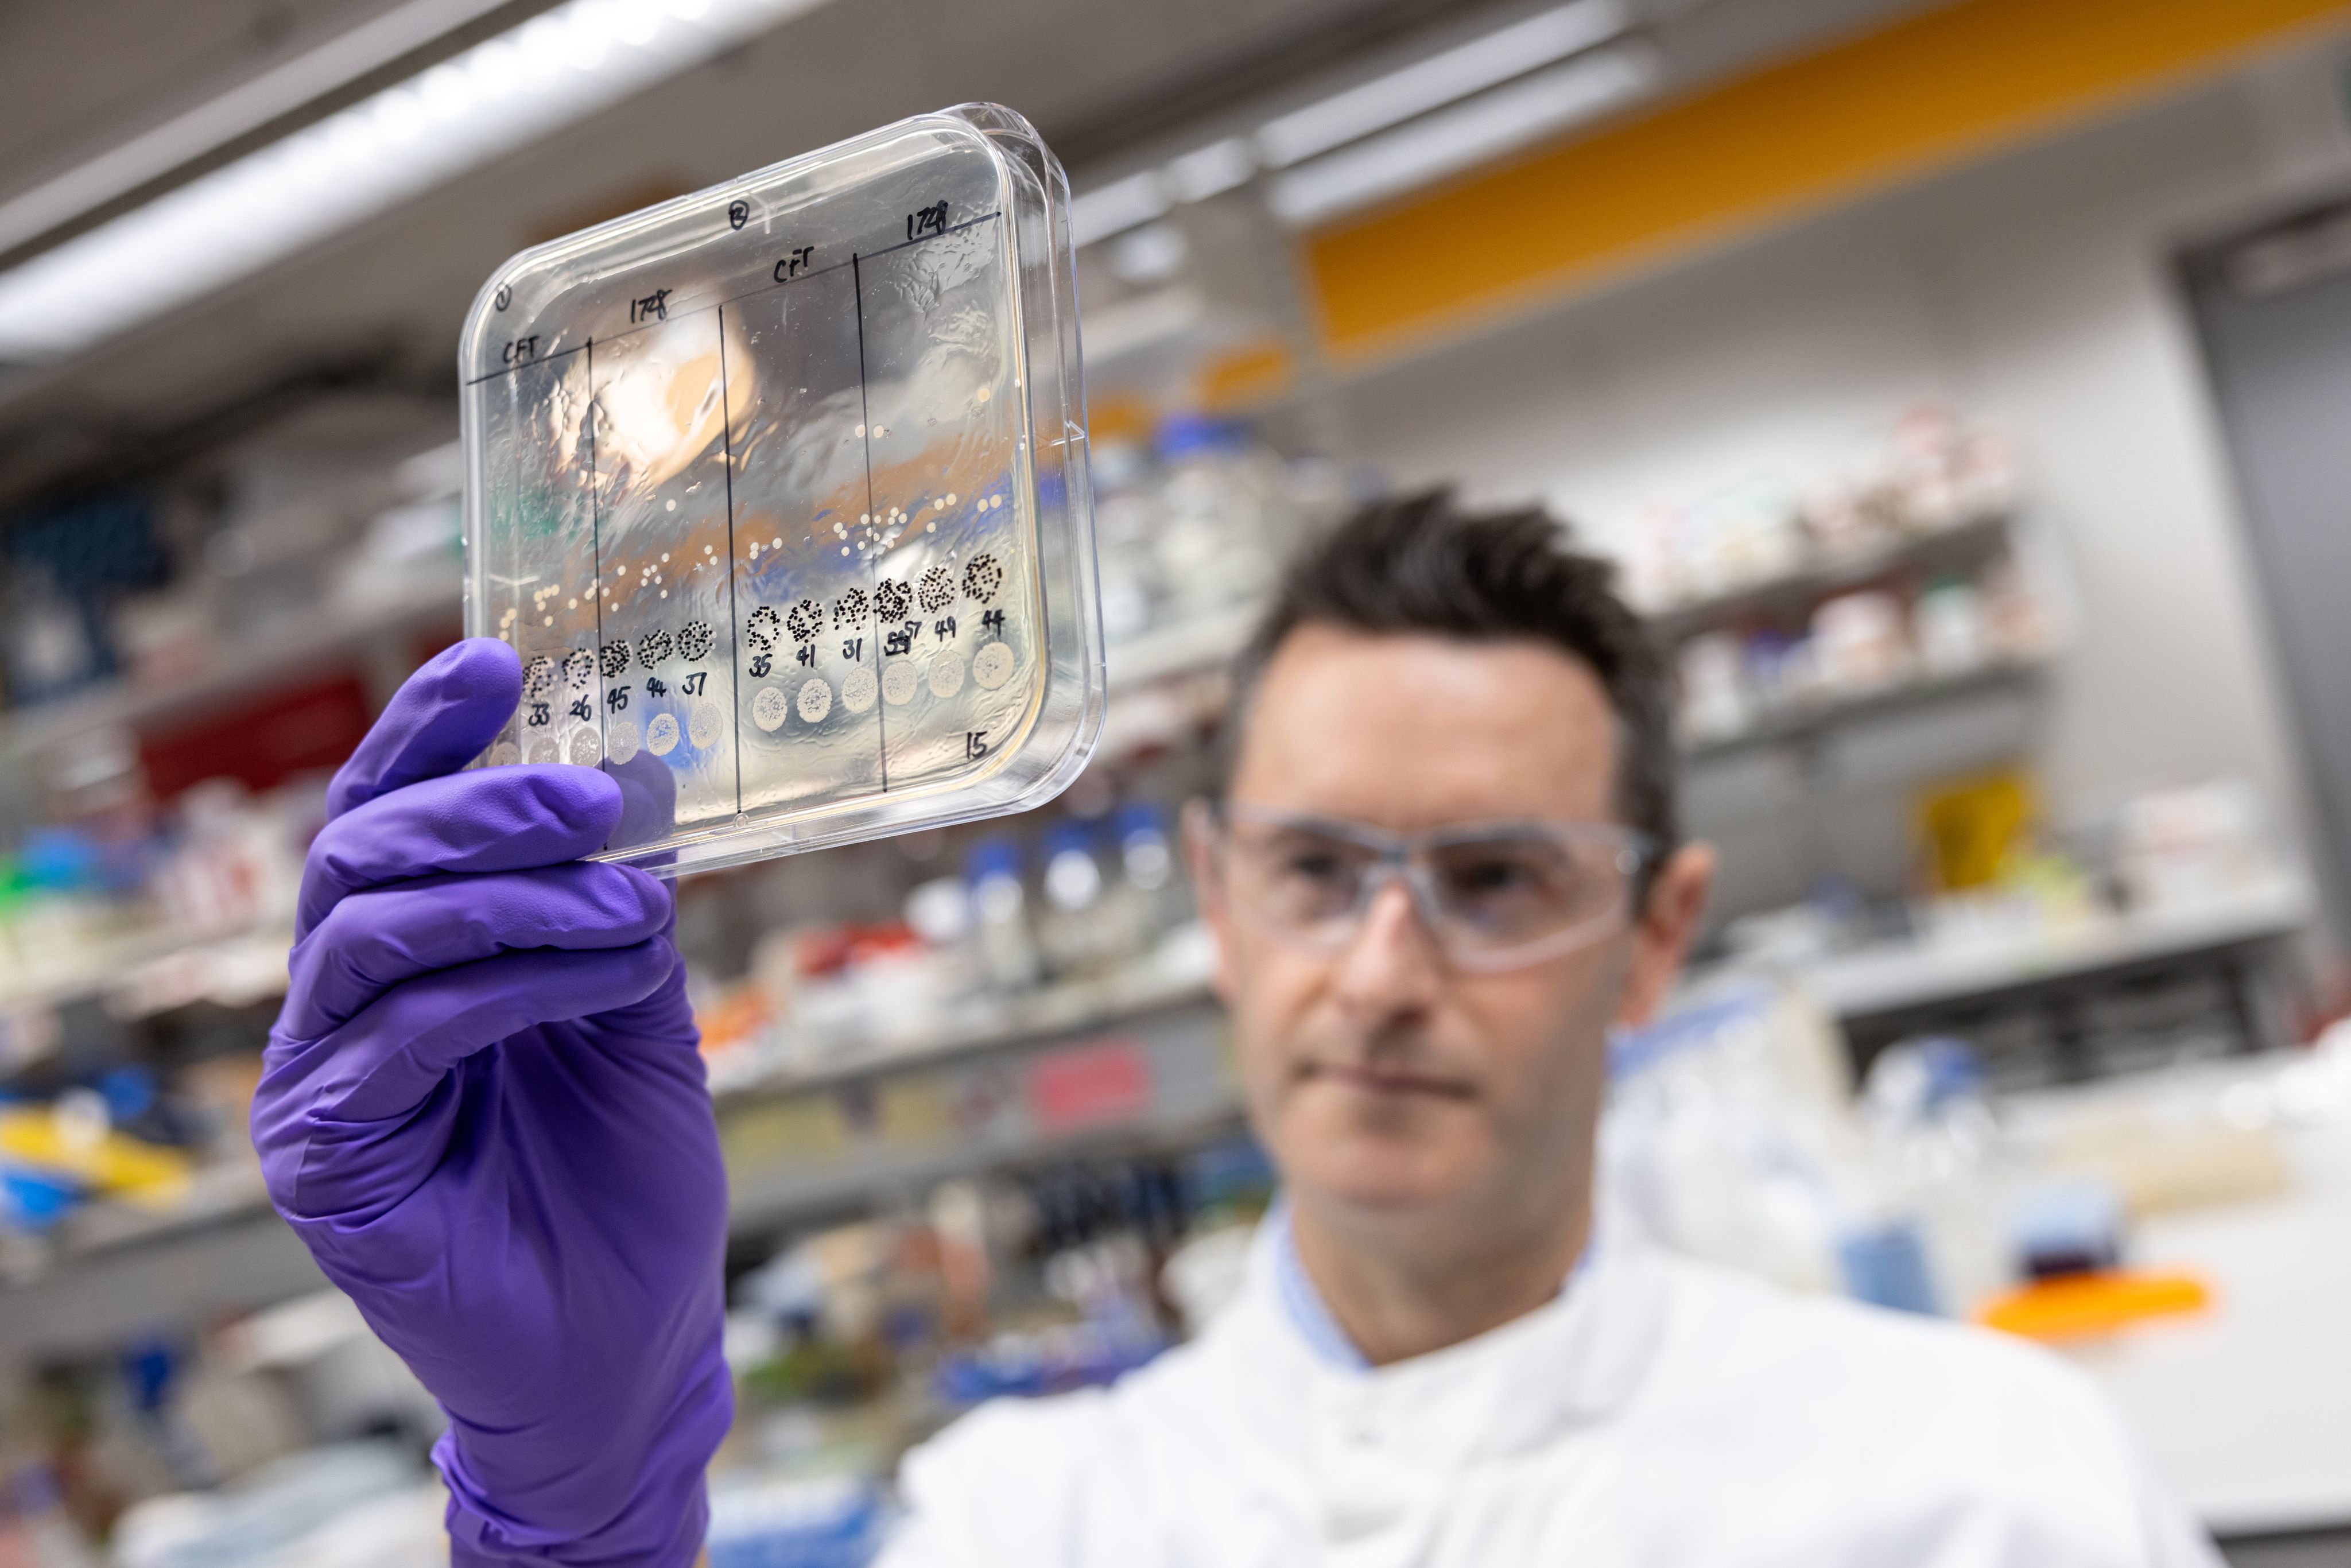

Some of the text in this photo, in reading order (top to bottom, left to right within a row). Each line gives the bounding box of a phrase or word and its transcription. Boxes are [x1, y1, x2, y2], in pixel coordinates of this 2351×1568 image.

[503, 336, 540, 363] CFT
[934, 616, 956, 642] 49
[981, 609, 1006, 636] 44
[749, 638, 863, 678] 35 41 31
[529, 694, 592, 727] 33 26
[967, 731, 988, 759] 15
